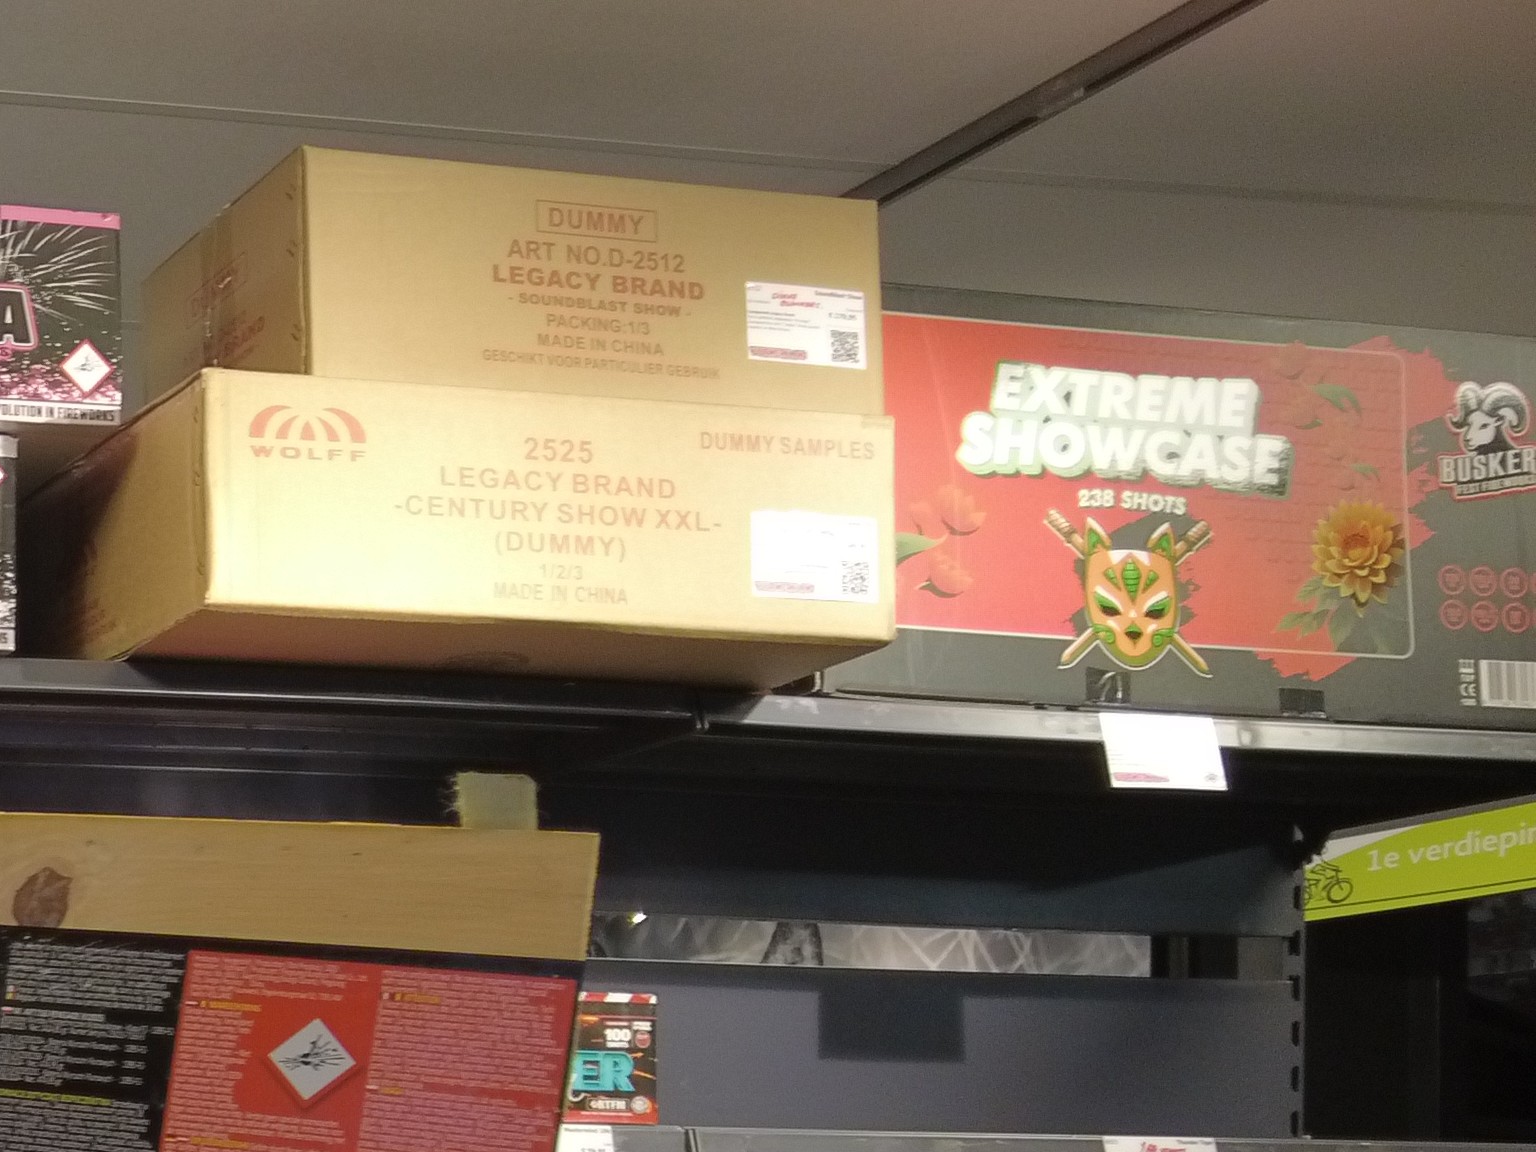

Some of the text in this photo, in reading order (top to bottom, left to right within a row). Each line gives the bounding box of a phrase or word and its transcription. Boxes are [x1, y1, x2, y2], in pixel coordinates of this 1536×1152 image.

[548, 207, 644, 235] DUMMY
[508, 239, 685, 274] ART NO.D-2512
[492, 264, 705, 300] LEGACY BRAND
[519, 292, 682, 318] SOUNDBLAST SHOW
[537, 334, 664, 356] MADE IN CHINA
[482, 349, 721, 380] GESCHIKT VOOR PARTICULIER GEBRUIK
[993, 361, 1260, 435] EXTREME
[44, 404, 55, 419] IN
[57, 405, 116, 424] FIREWORKS
[249, 445, 367, 462] WOLFF
[523, 437, 593, 464] 2525
[699, 431, 876, 461] DUMMY SAMPLES
[958, 410, 1292, 497] SHOWCASE
[440, 465, 677, 499] LEGACY BRAND
[1078, 488, 1186, 515] 238 SHOTS
[557, 502, 646, 529] SHOW
[494, 530, 627, 561] (DUMMY)
[539, 564, 583, 580] 1/2/3
[494, 581, 628, 606] MADE IN CHINA
[1368, 849, 1399, 872] 1e
[605, 1029, 632, 1042] 100
